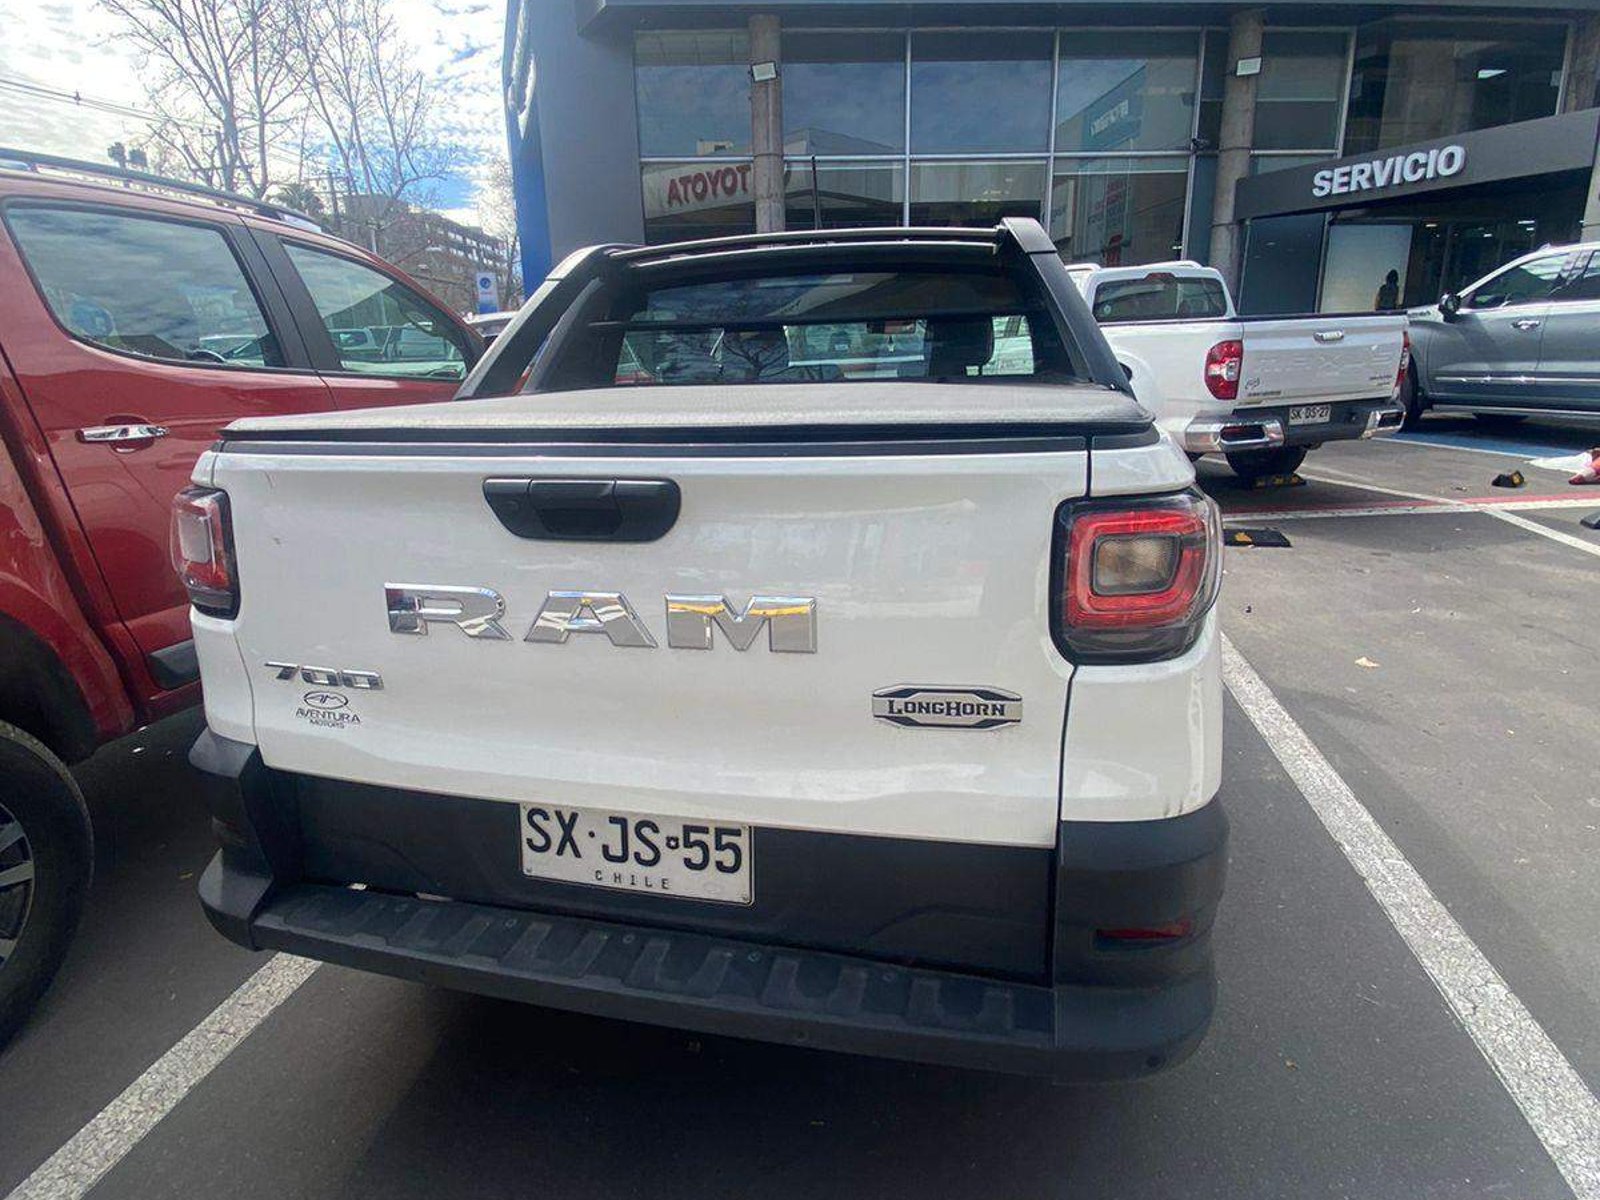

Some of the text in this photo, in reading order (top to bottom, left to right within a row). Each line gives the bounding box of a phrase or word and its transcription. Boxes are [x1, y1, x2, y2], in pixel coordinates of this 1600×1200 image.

[1312, 145, 1466, 197] SERVICIO
[384, 582, 818, 654] RAM
[264, 661, 384, 690] 700
[295, 708, 361, 722] AVENTURA
[594, 869, 669, 890] CHILE
